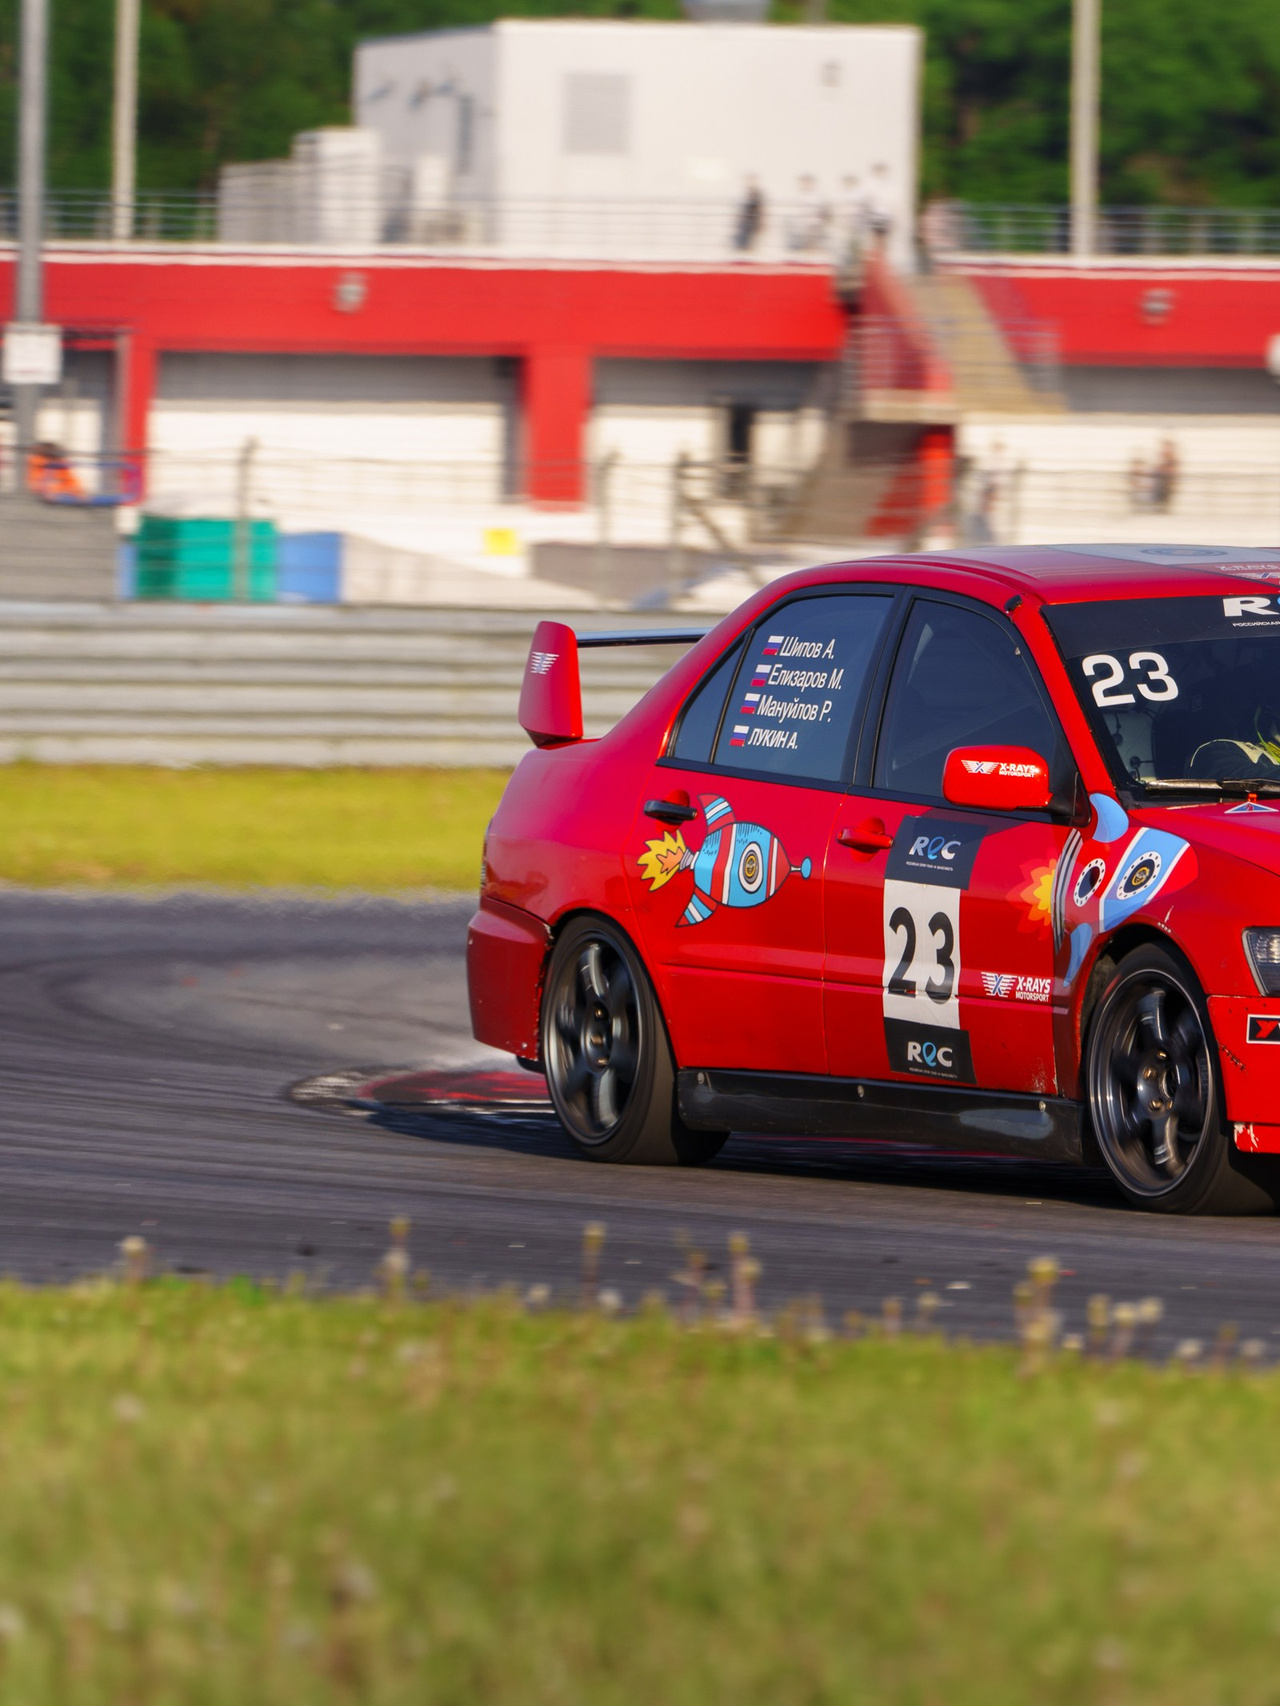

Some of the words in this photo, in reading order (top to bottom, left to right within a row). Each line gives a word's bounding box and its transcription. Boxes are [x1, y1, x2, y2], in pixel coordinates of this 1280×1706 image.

[779, 636, 823, 658] Шипов
[822, 638, 836, 660] А.
[767, 663, 828, 693] Елизаров
[827, 668, 845, 690] М.
[1081, 651, 1179, 708] 23
[756, 694, 819, 724] Мануйлов
[818, 700, 832, 722] Р.
[999, 762, 1036, 773] X-RAYS
[887, 906, 955, 1005] 23
[1015, 990, 1050, 1002] MOTORSPORT
[1016, 976, 1051, 994] X-RAYS
